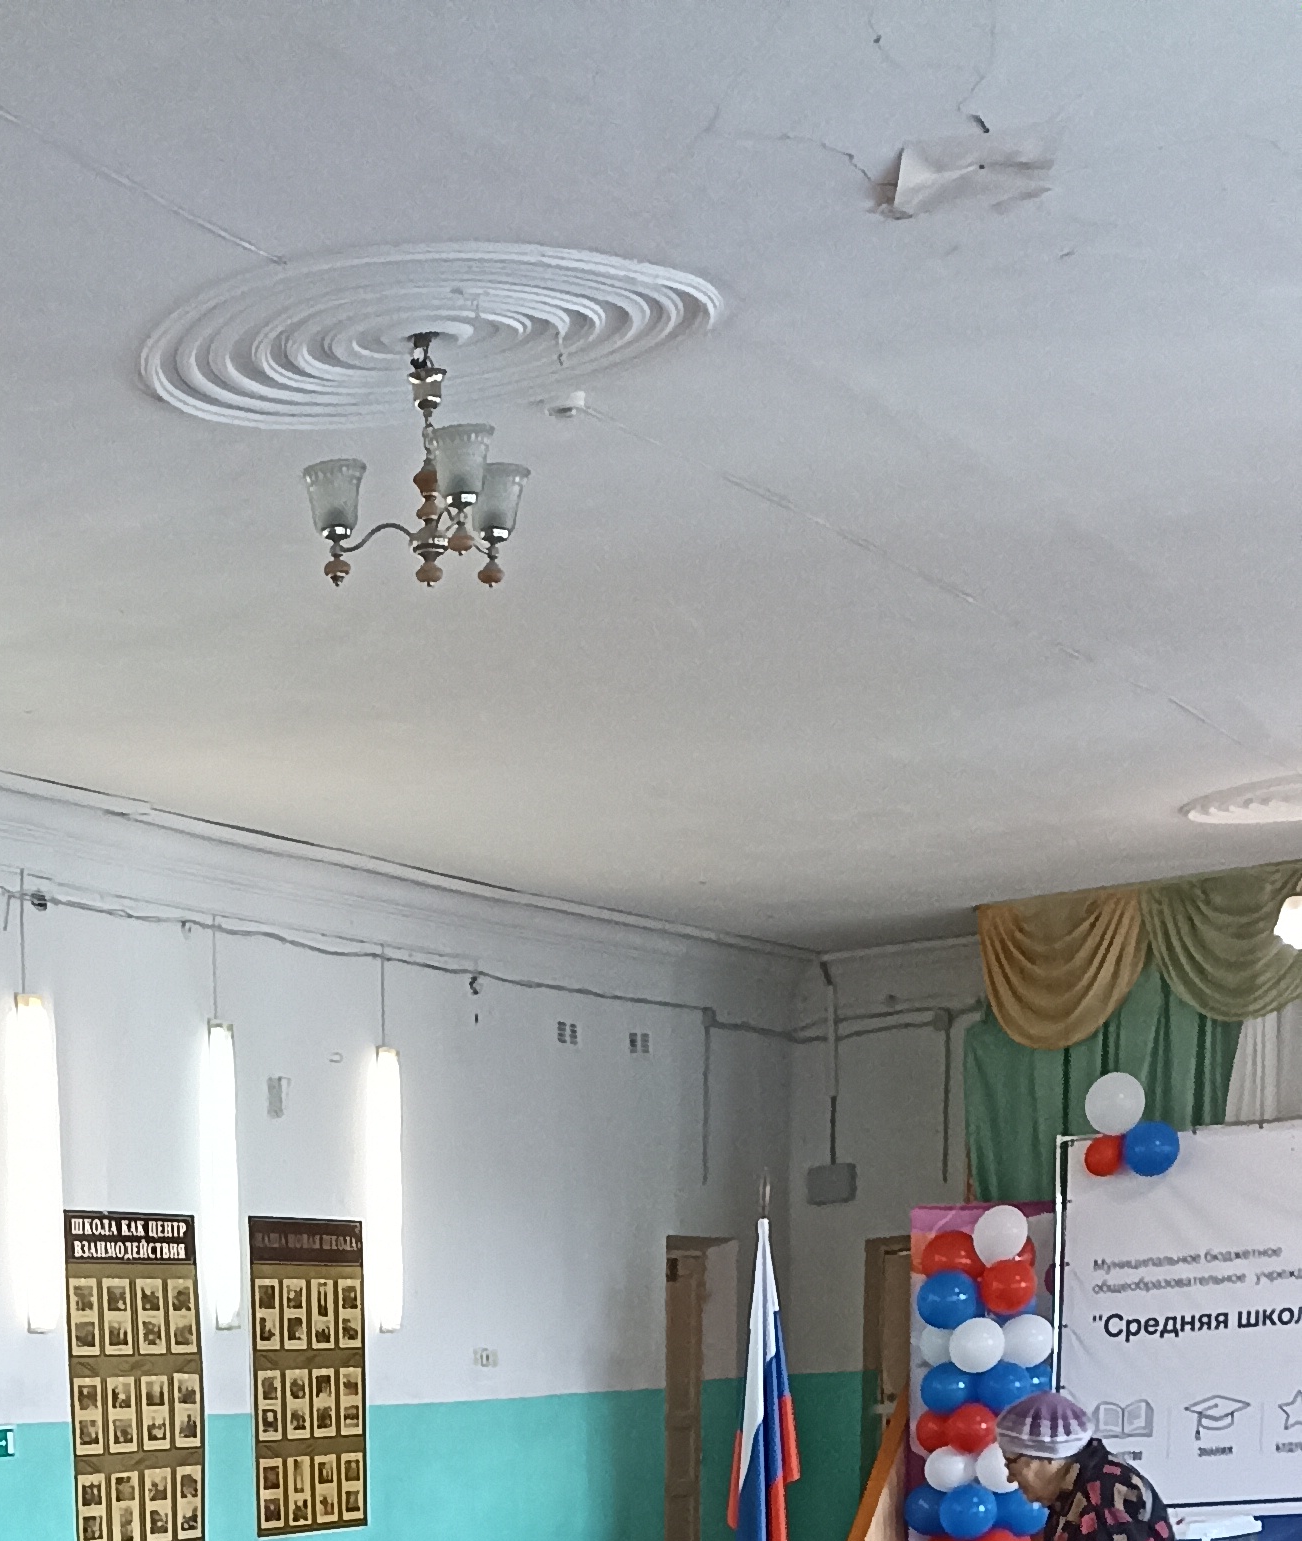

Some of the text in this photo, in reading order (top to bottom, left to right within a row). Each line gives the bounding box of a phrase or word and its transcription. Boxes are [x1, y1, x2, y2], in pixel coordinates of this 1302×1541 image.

[71, 1218, 187, 1239] ШКОЛА КАК ЦЕНТР
[74, 1239, 186, 1261] ВЗАИМОДЕЙСТВИЯ
[1092, 1311, 1229, 1343] "Средняя
